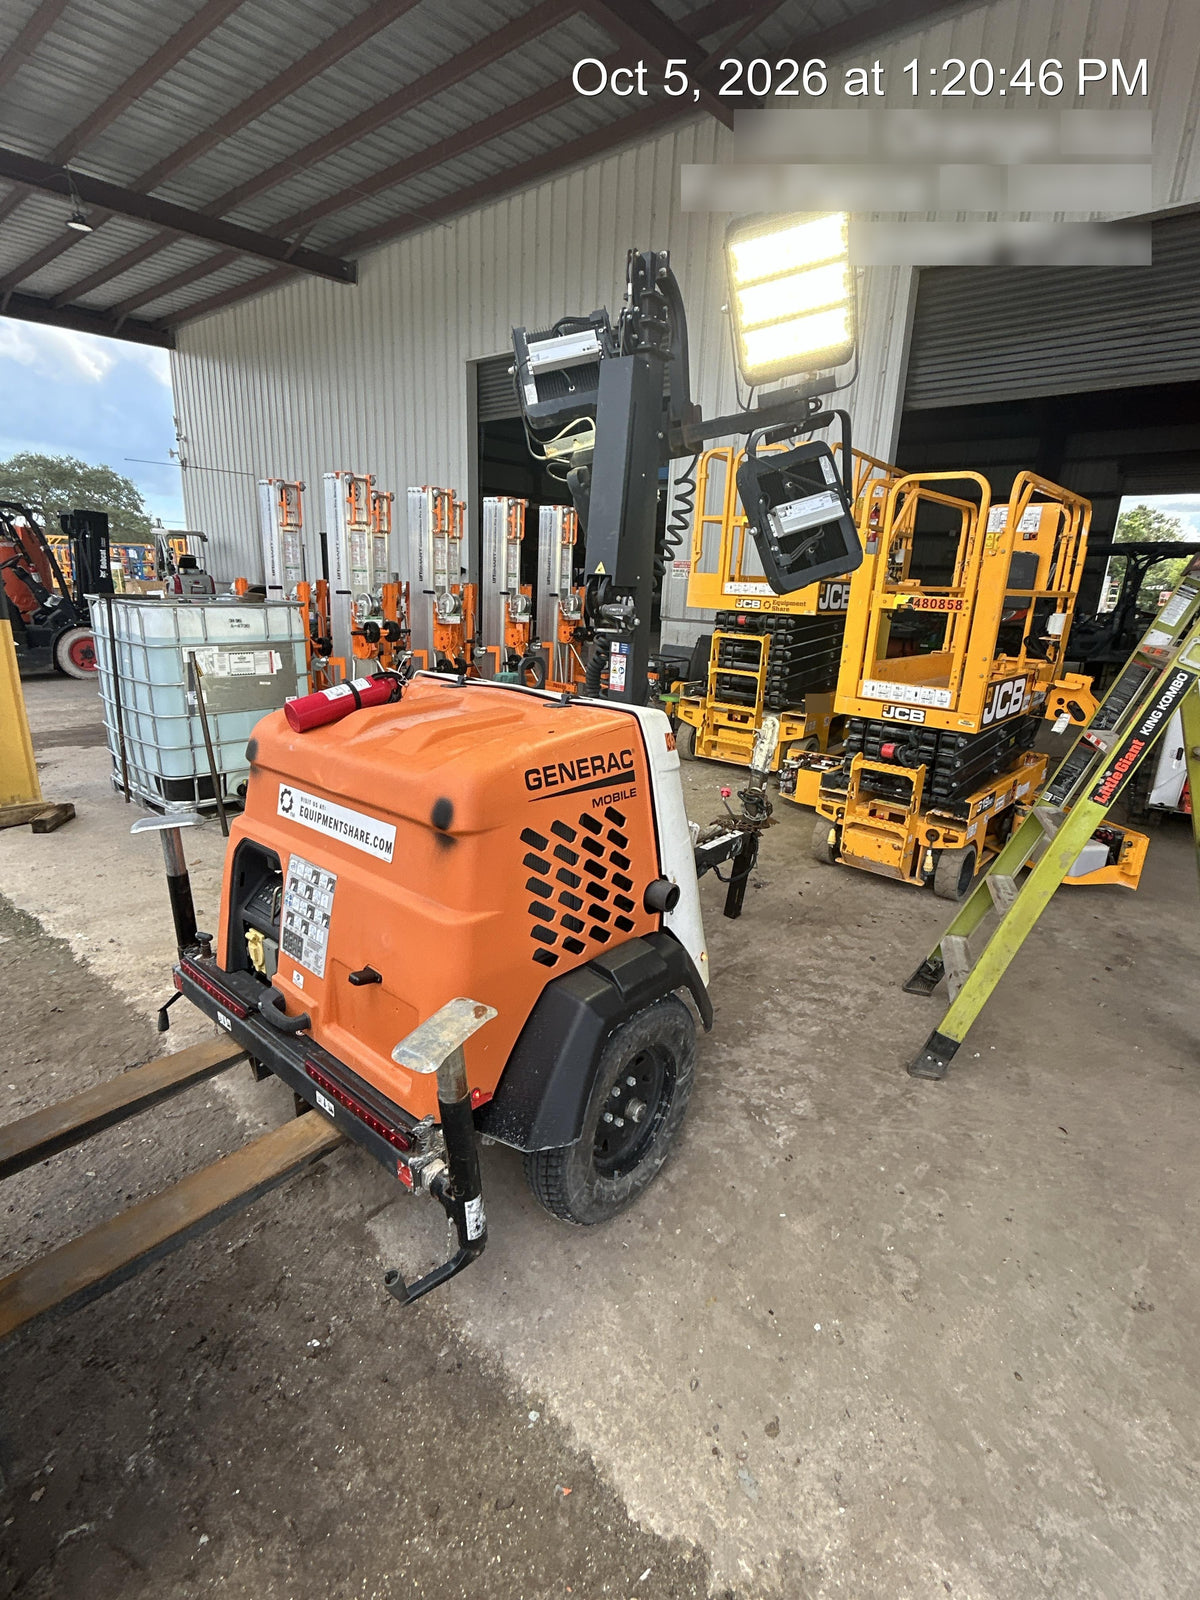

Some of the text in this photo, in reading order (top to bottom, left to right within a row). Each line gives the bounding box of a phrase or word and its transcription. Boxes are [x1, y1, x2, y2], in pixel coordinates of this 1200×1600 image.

[735, 599, 761, 609] JCB
[819, 584, 850, 609] JCB
[913, 598, 963, 611] 480858
[882, 705, 926, 722] JCB
[983, 678, 1027, 725] JCB
[1140, 672, 1188, 736] KING KOMBO
[524, 749, 635, 791] GENERAC
[1094, 771, 1123, 804] Little
[1114, 737, 1146, 773] Giant
[591, 787, 638, 808] MOBILE
[299, 805, 393, 855] EQUIPMENTSHARE.COM
